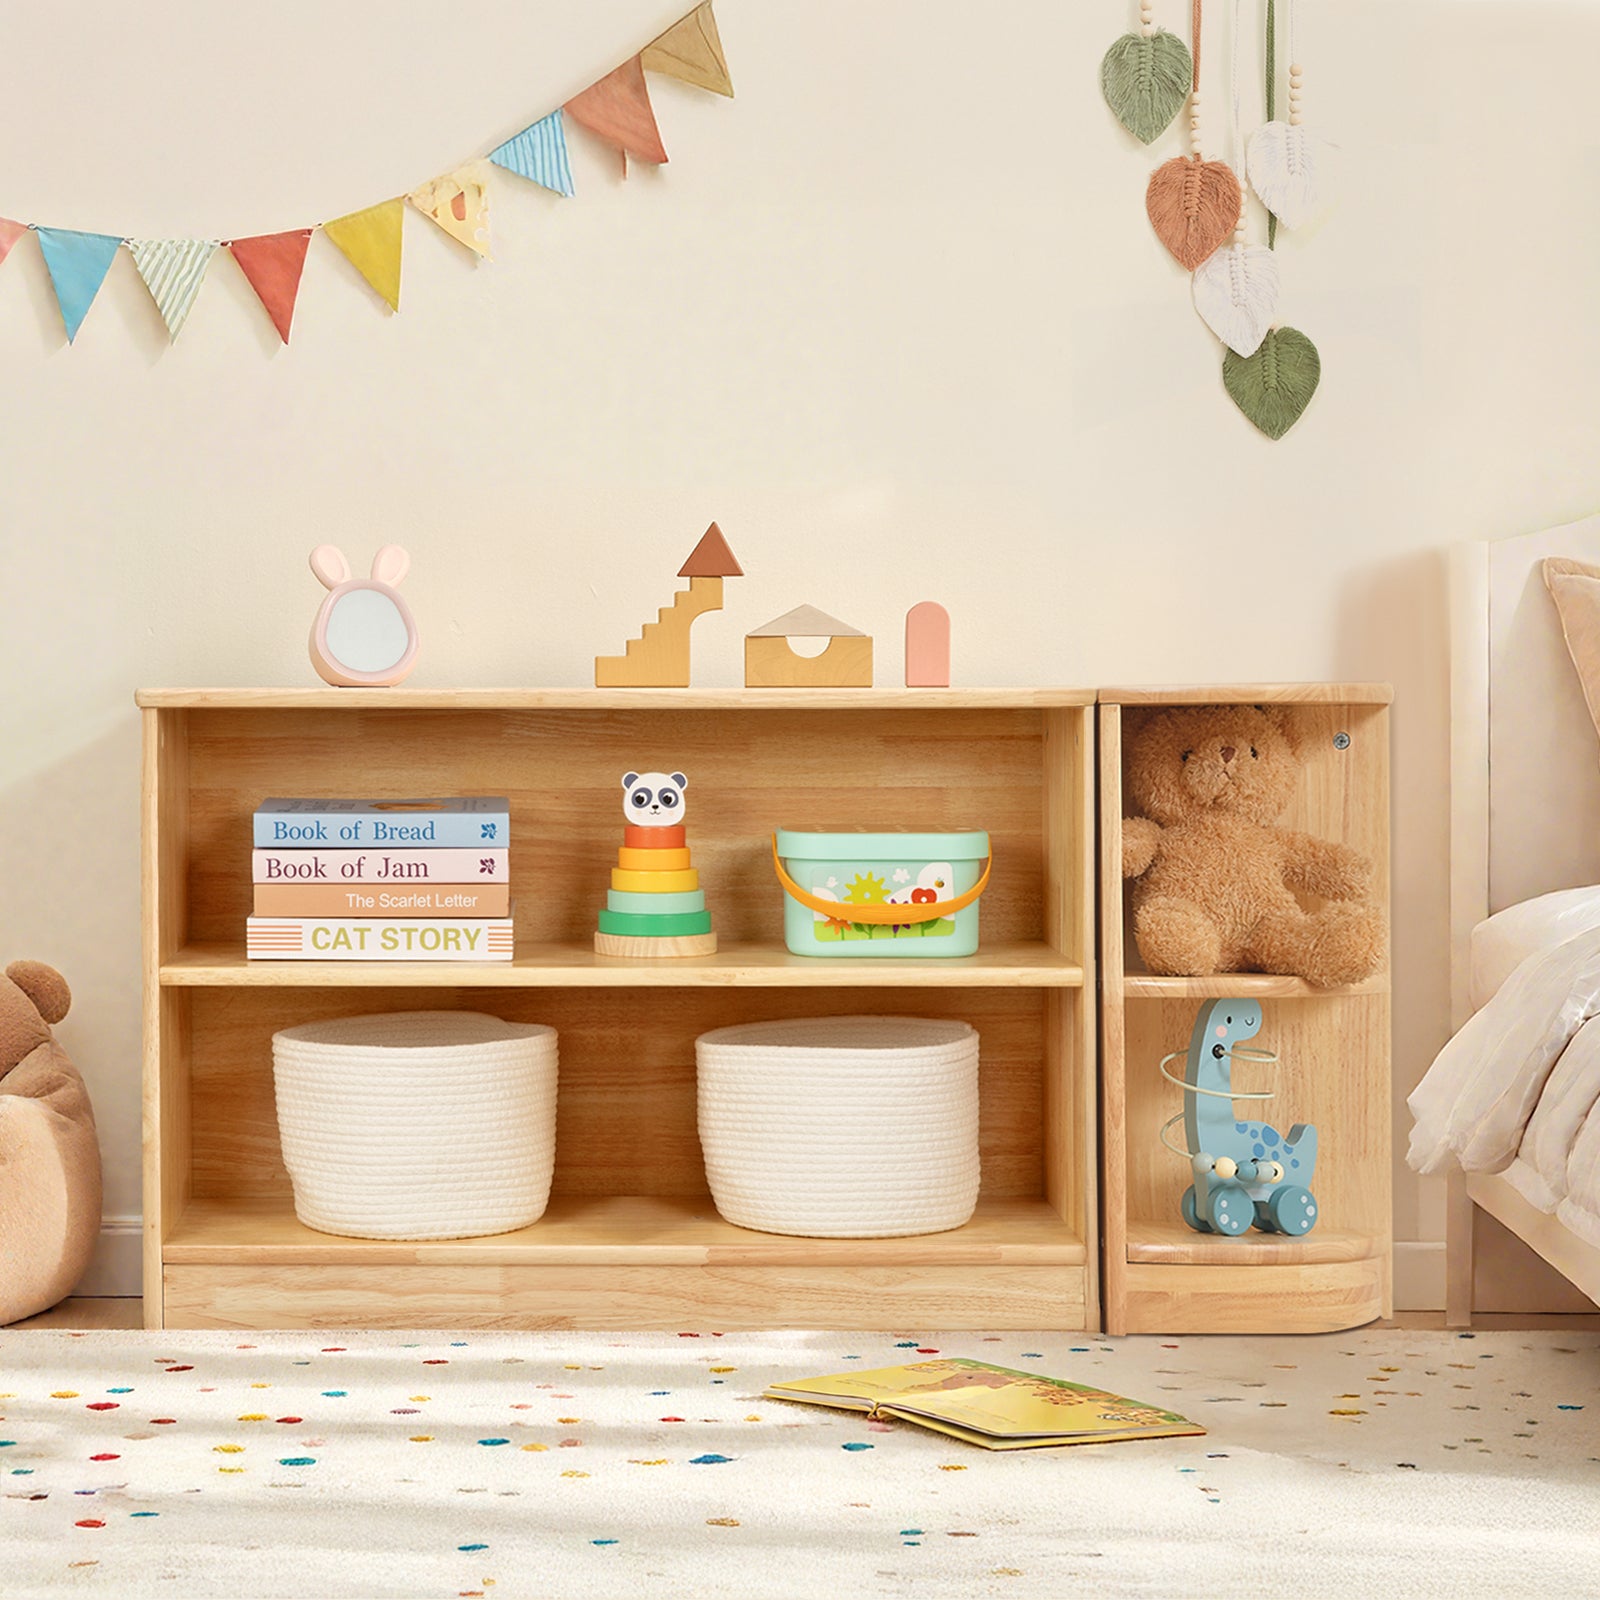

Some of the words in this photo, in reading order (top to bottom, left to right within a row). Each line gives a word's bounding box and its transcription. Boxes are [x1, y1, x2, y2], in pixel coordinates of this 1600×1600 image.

[274, 821, 328, 840] Book
[340, 821, 362, 840] of
[373, 821, 435, 840] Bread
[266, 857, 327, 878] Book
[341, 857, 366, 878] of
[377, 857, 429, 878] Jam
[346, 893, 374, 907] The
[379, 893, 431, 908] Scarlet
[435, 893, 478, 908] Letter
[311, 927, 371, 950] CAT
[380, 927, 481, 950] STORY
